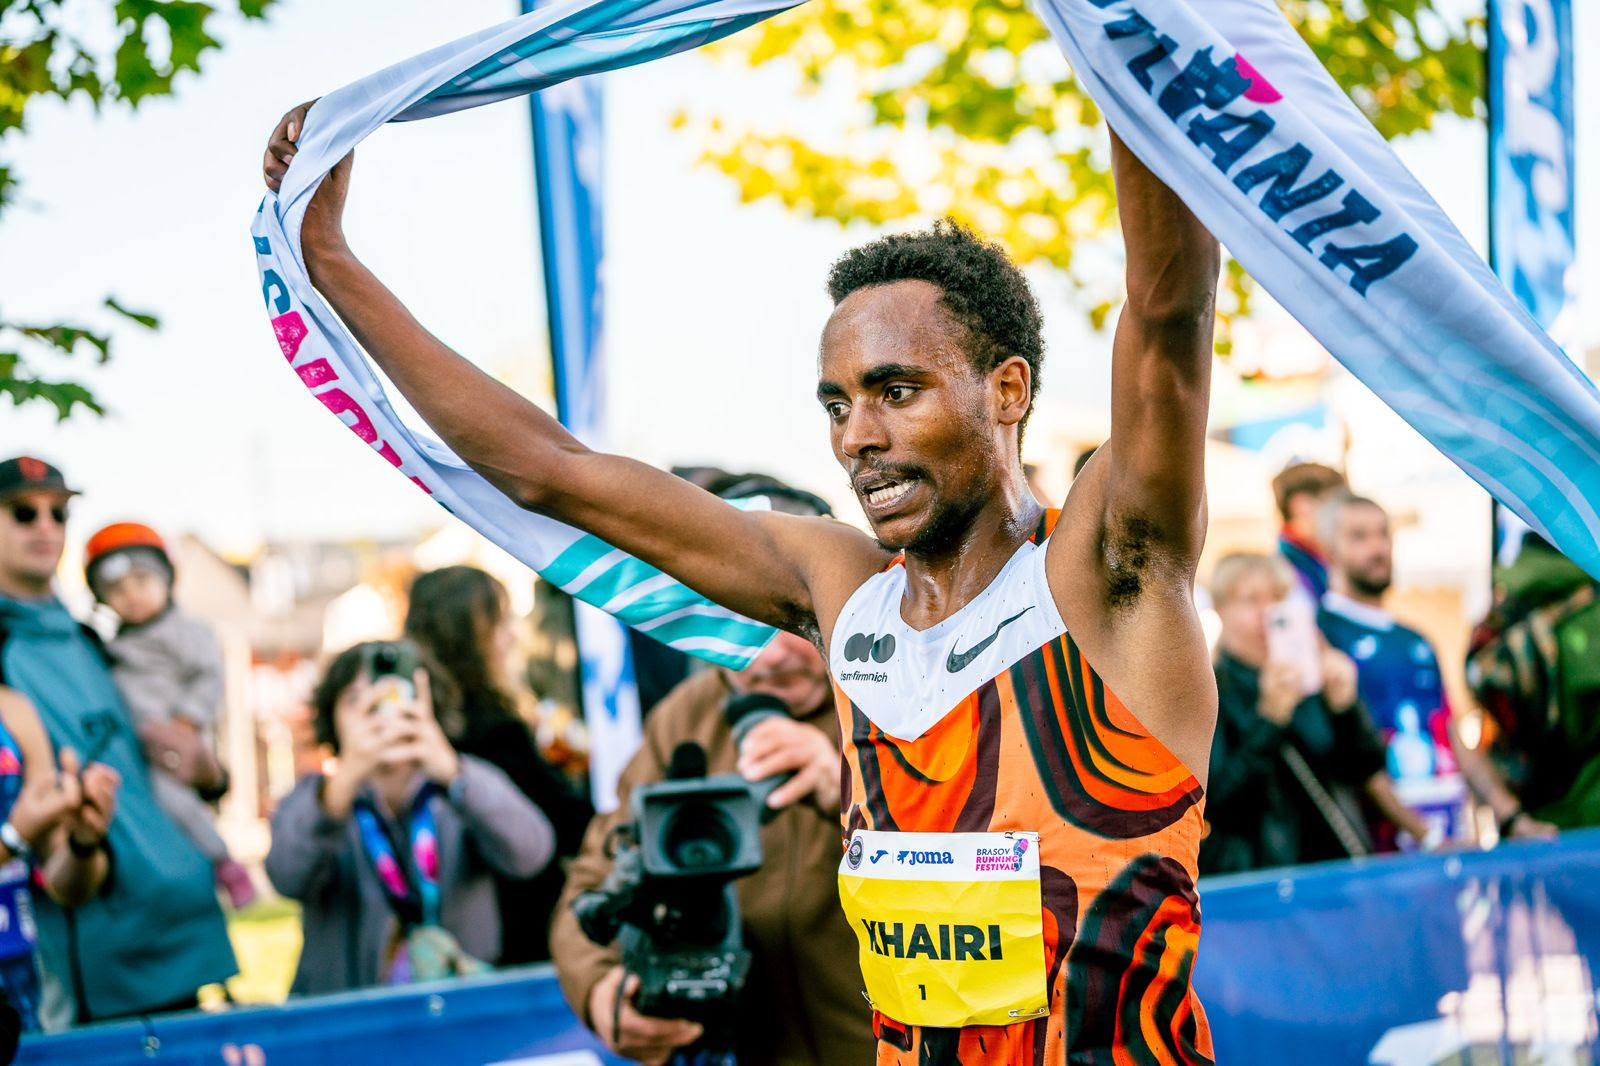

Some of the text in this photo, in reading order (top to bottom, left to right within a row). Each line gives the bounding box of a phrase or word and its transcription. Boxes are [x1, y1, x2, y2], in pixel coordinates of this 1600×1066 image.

[976, 848, 1011, 856] BRASOV
[975, 863, 1015, 871] FESTIVAL
[861, 918, 1003, 960] KHAIRI
[918, 984, 927, 1001] 1
